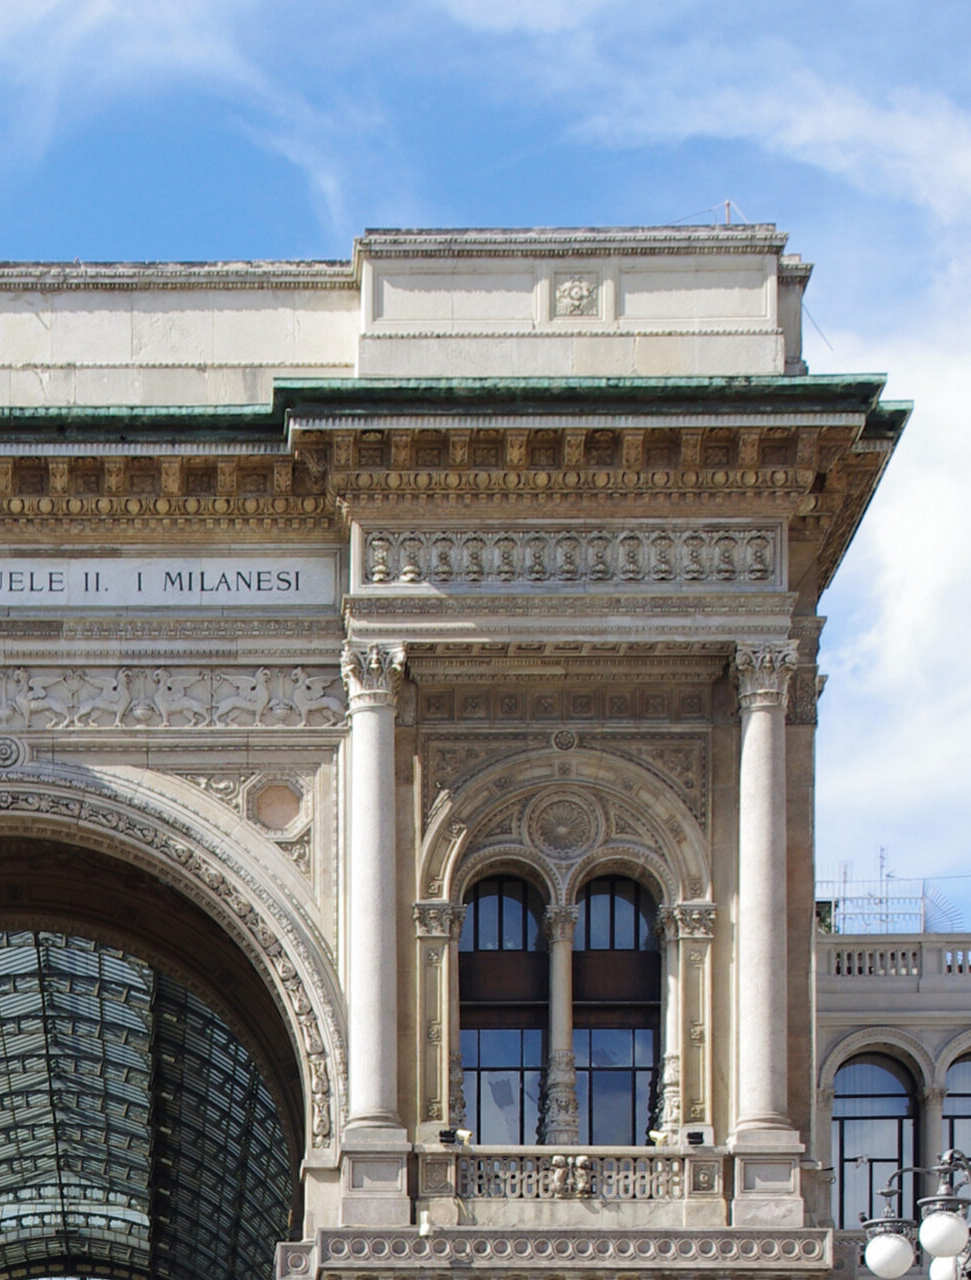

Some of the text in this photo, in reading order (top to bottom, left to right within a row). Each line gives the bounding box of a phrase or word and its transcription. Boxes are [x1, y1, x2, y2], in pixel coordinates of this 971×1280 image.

[83, 571, 109, 592] II.
[136, 571, 143, 592] I
[163, 571, 301, 592] MILANESI
